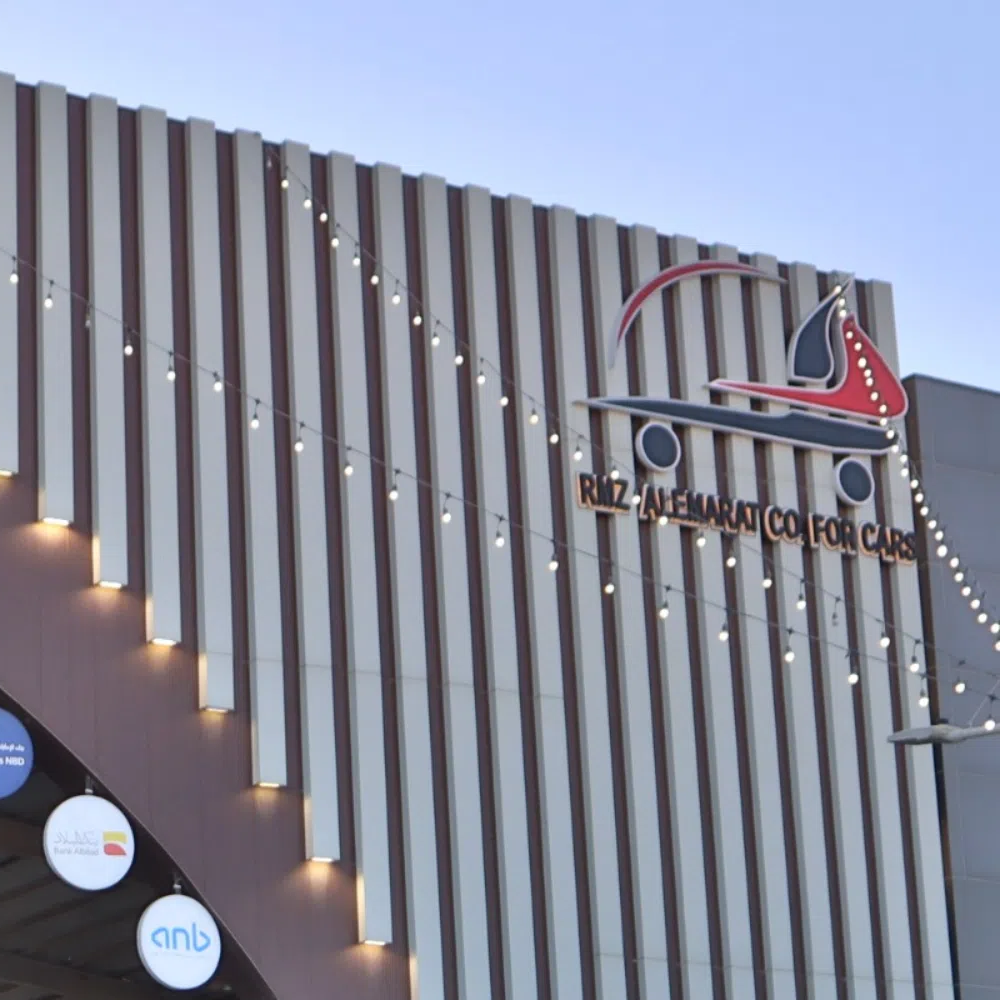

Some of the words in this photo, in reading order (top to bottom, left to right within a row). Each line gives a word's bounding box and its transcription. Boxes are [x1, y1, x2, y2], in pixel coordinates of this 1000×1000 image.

[808, 511, 858, 555] FOR
[858, 520, 918, 567] CARS
[5, 756, 26, 767] NBD
[151, 922, 211, 952] anb
